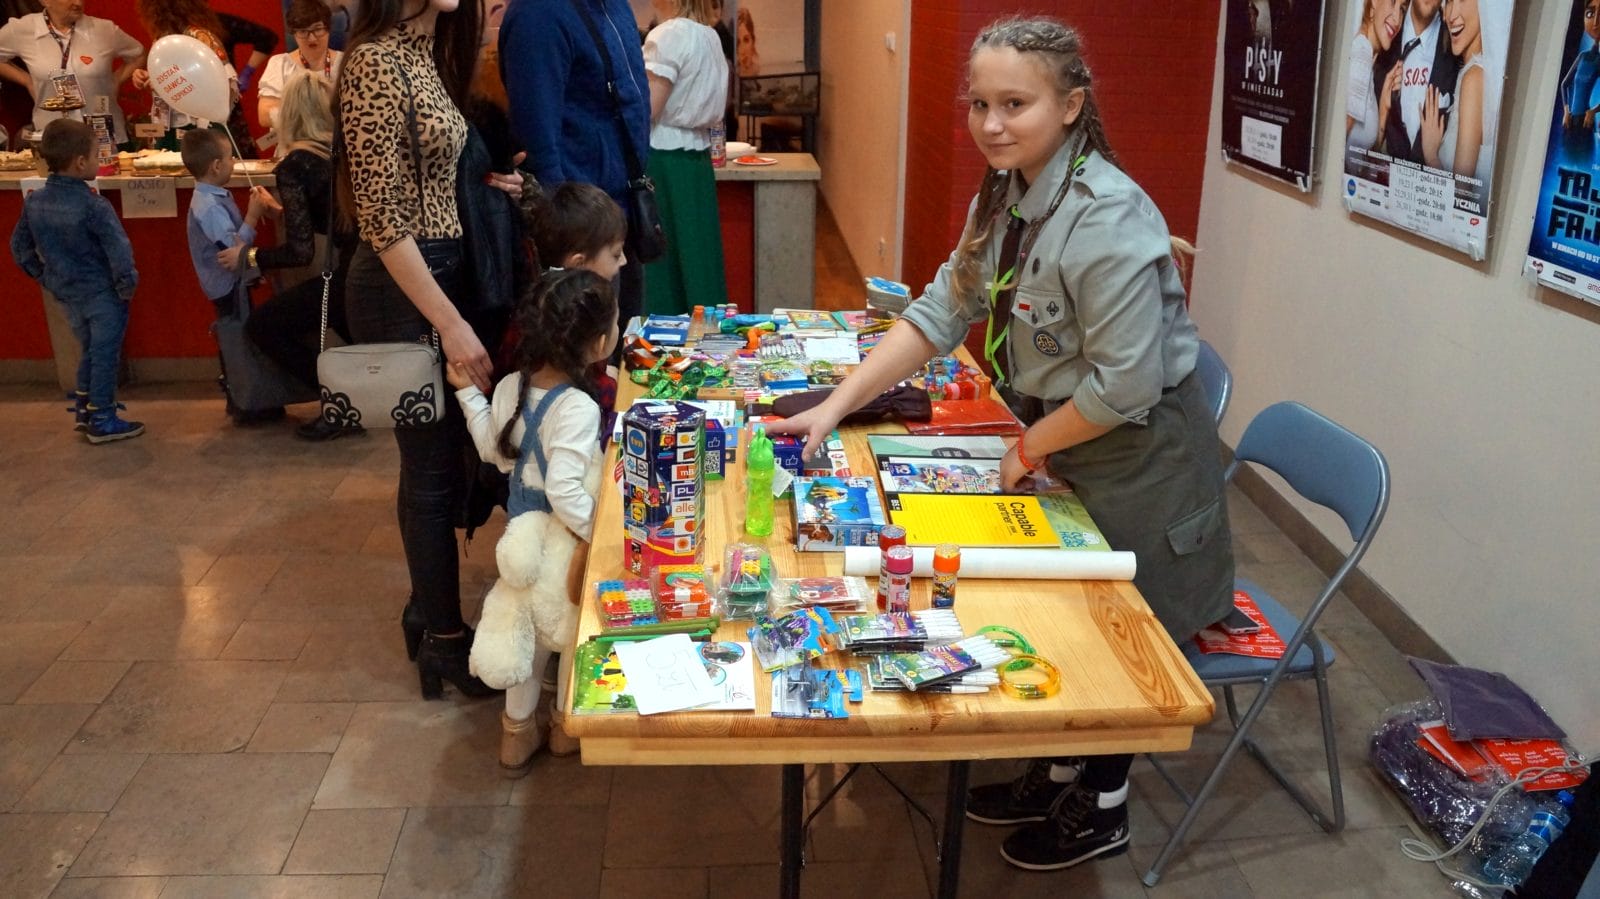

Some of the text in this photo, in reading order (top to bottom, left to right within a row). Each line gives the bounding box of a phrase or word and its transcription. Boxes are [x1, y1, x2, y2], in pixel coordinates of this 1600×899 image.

[1245, 46, 1282, 85] PSY
[1455, 197, 1480, 213] YCZNIA
[993, 502, 1014, 525] partner
[1010, 501, 1037, 537] Capable
